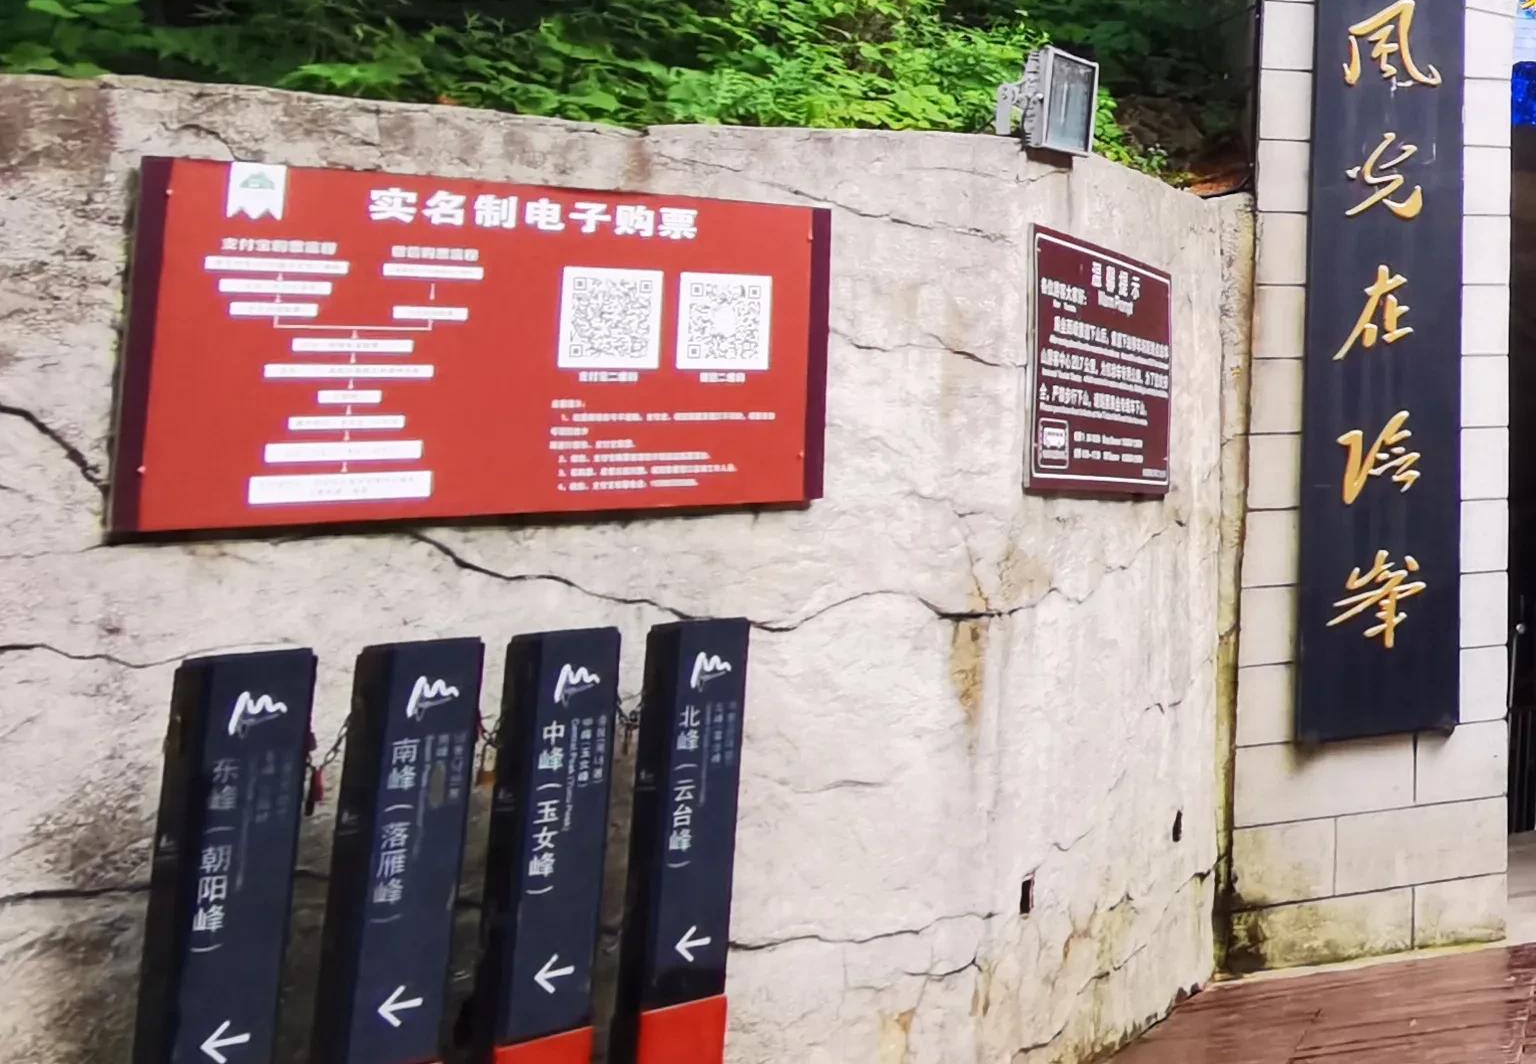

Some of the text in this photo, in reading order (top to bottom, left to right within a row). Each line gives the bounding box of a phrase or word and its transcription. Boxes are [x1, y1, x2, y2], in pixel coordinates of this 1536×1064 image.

[368, 187, 698, 240] 实名制电子购票
